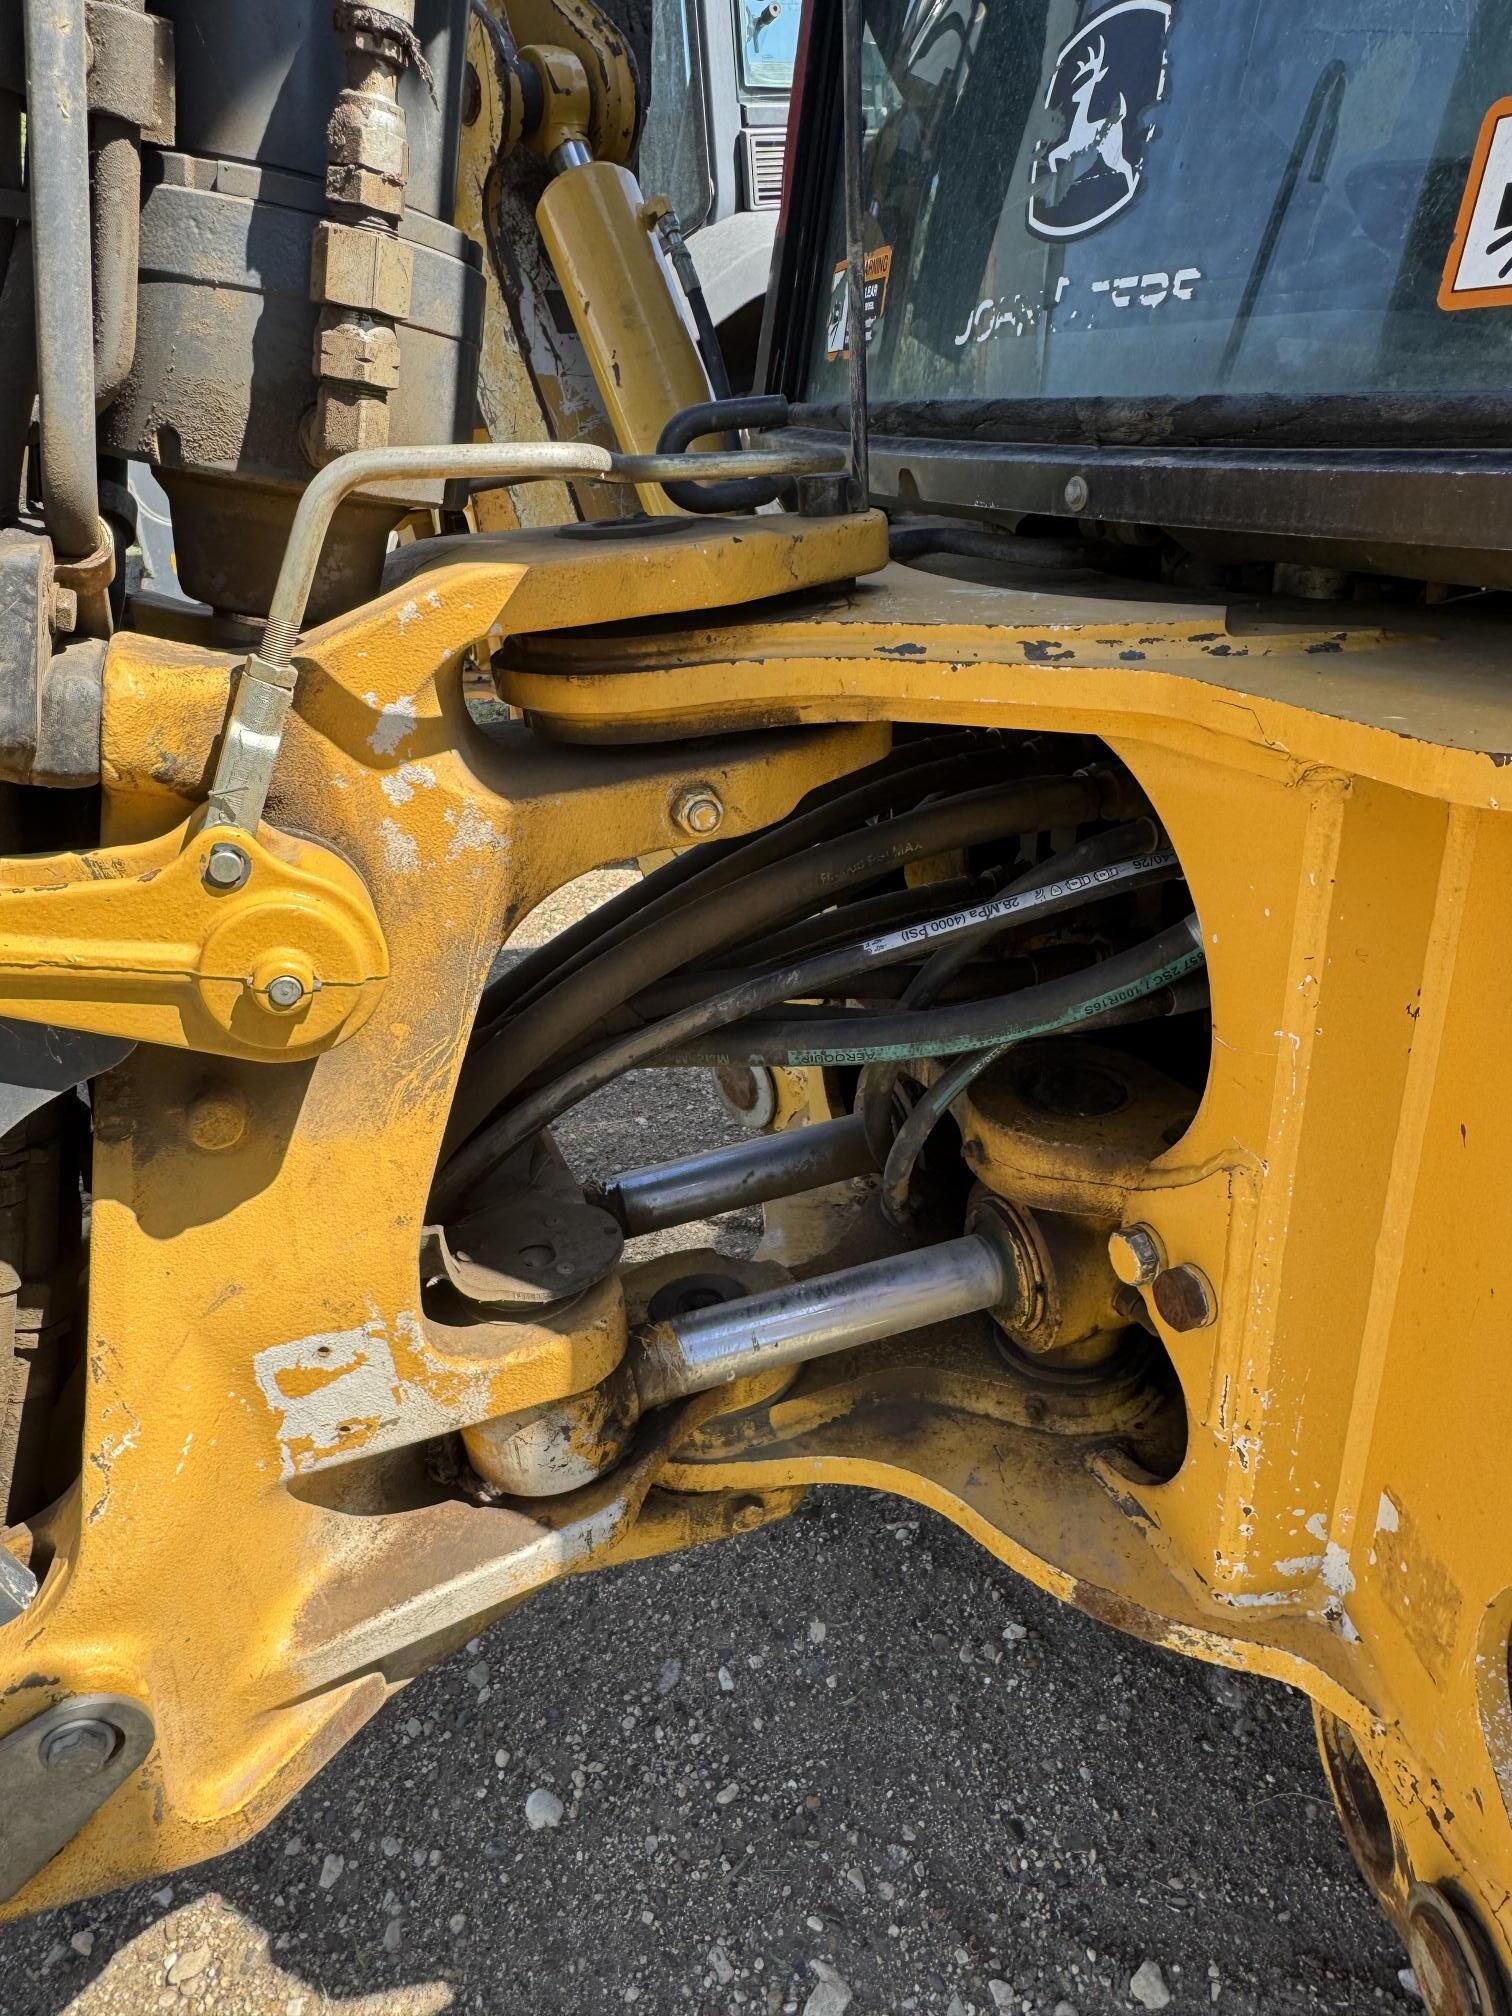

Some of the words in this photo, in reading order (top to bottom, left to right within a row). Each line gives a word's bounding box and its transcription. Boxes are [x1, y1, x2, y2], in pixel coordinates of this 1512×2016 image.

[864, 283, 879, 299] LEAR
[931, 915, 966, 932] (4000
[901, 928, 928, 942] PSI)
[1153, 966, 1181, 983] 2SC
[1083, 986, 1140, 1016] 100R16S
[800, 1049, 875, 1064] AEROQUIP
